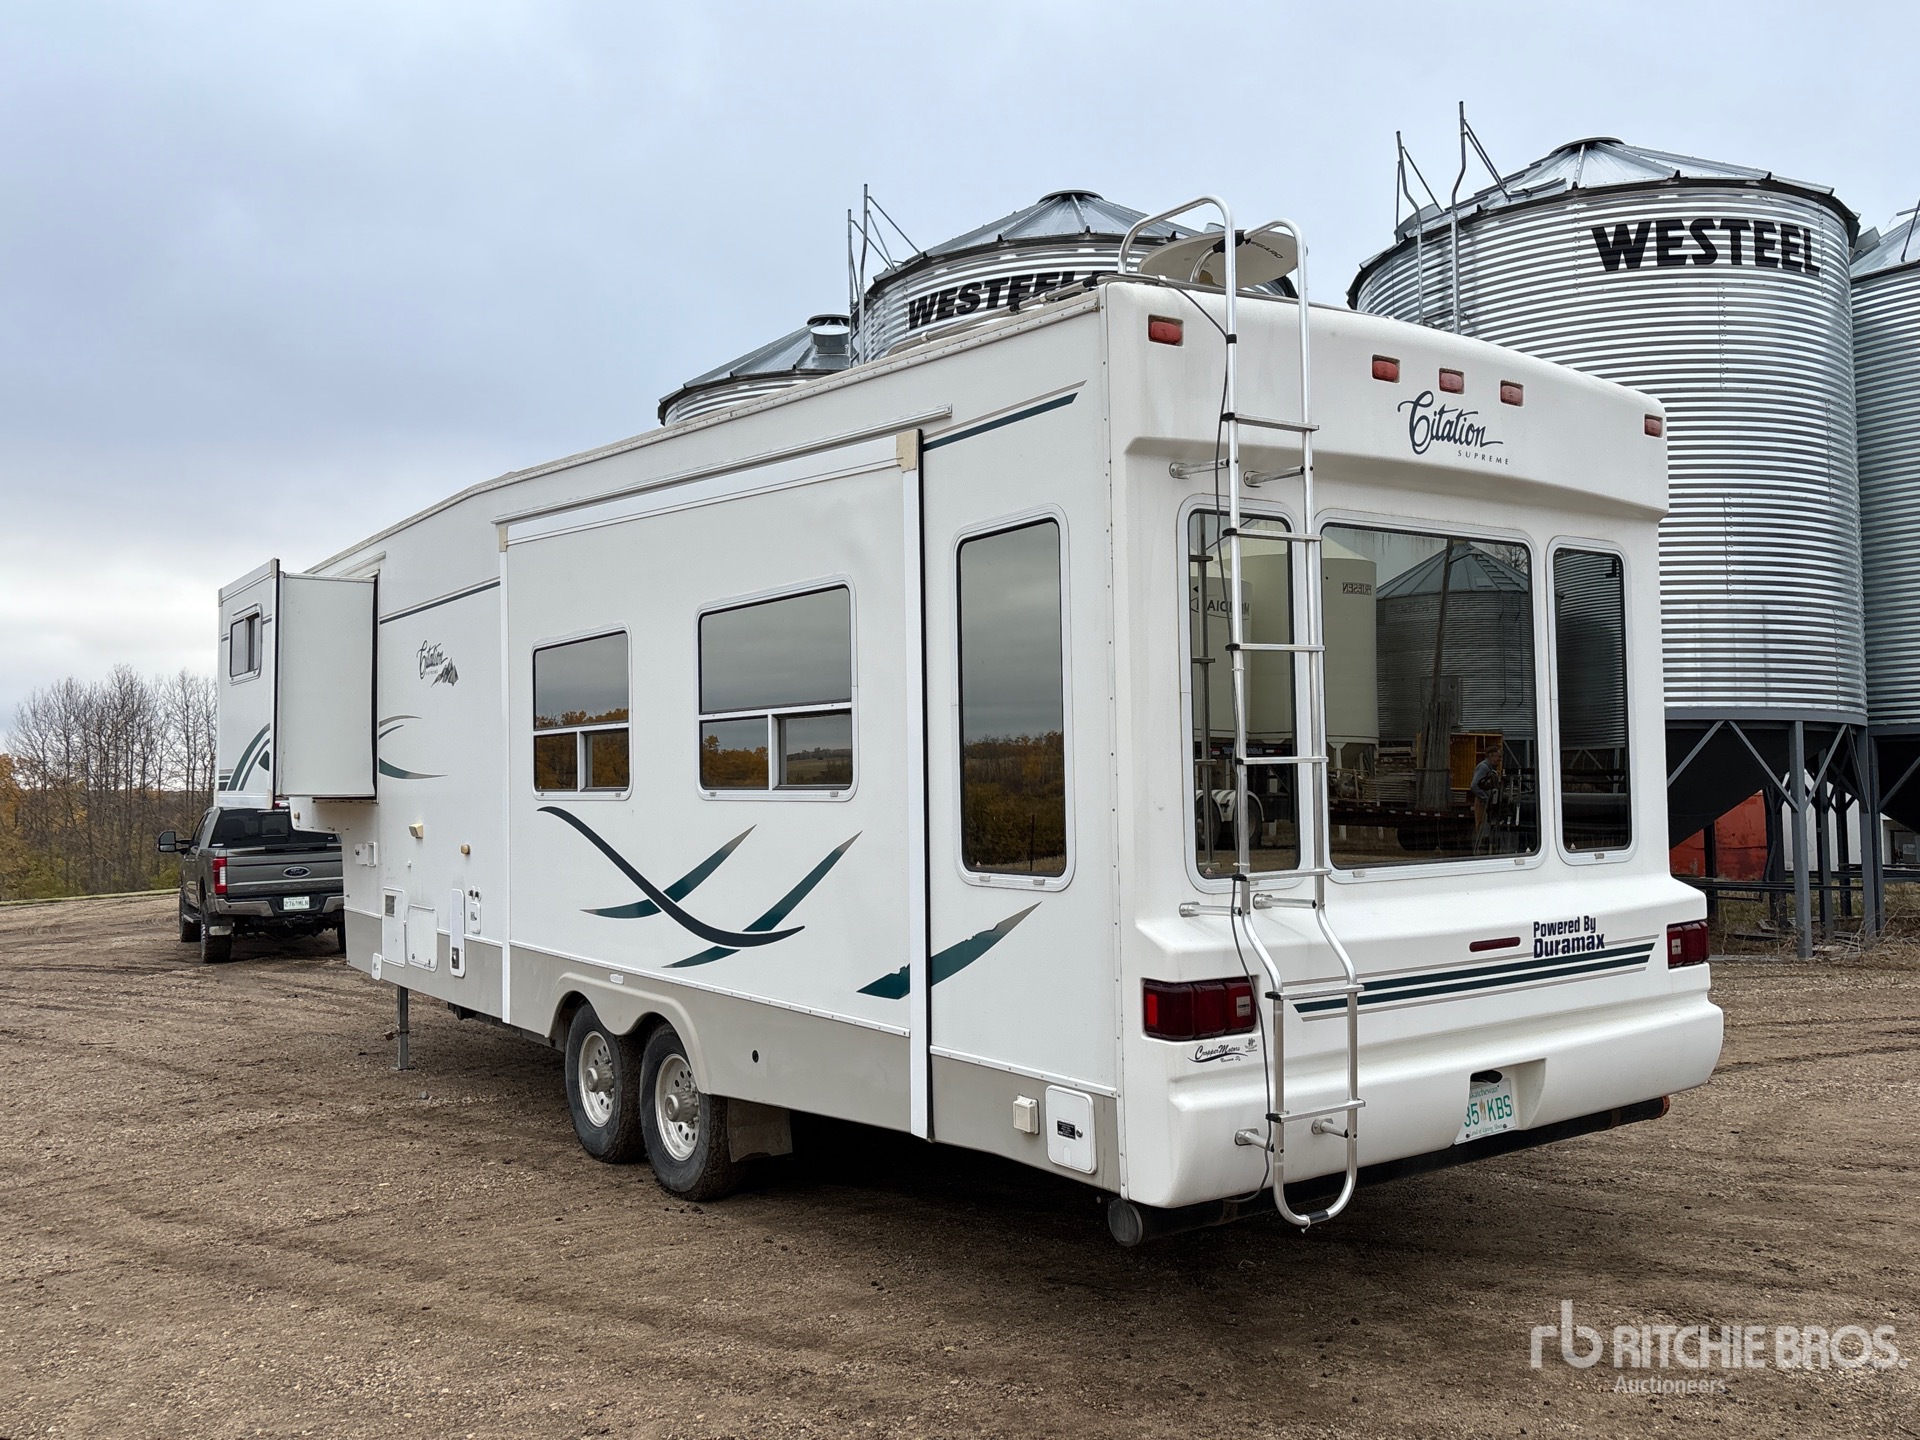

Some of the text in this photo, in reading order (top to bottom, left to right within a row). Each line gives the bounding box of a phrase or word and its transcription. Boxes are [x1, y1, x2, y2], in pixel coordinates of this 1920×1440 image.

[1591, 218, 1821, 277] WESTEEL
[1397, 390, 1504, 455] Citation
[1457, 450, 1510, 465] SUPREME
[1533, 915, 1596, 938] Powered By
[1533, 934, 1605, 958] Duramax
[1487, 1094, 1513, 1121] KBS
